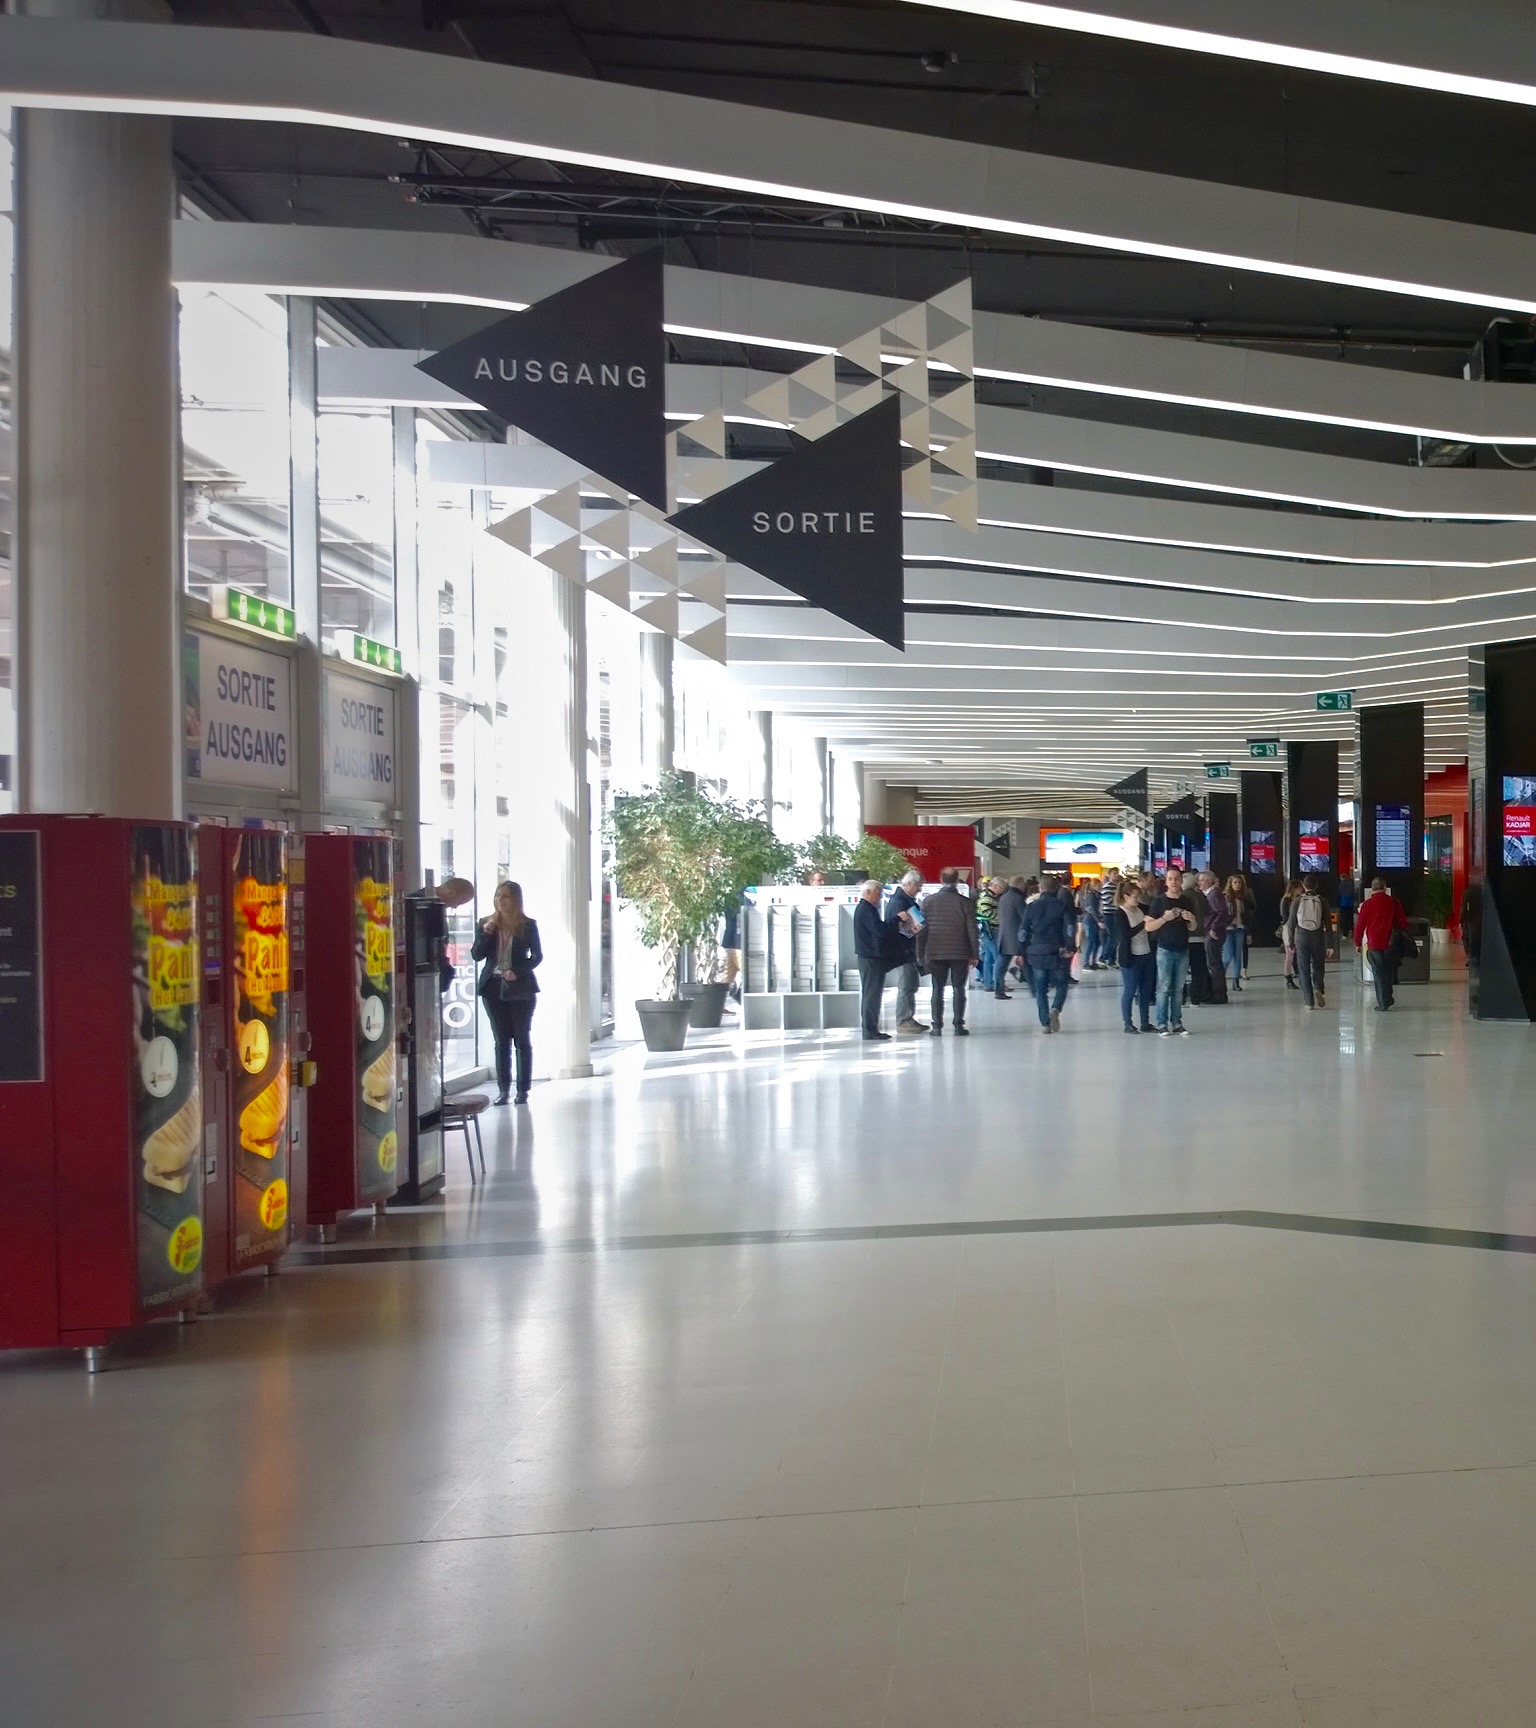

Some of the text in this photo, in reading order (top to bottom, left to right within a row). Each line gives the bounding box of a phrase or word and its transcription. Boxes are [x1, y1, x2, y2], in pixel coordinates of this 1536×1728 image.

[474, 357, 647, 389] AUSGANG
[752, 511, 876, 534] SORTIE
[217, 664, 276, 711] SORTIE
[341, 698, 384, 736] SORTIE
[206, 720, 286, 767] AUSGANG
[333, 745, 392, 783] AUSGANG
[898, 847, 929, 857] anque
